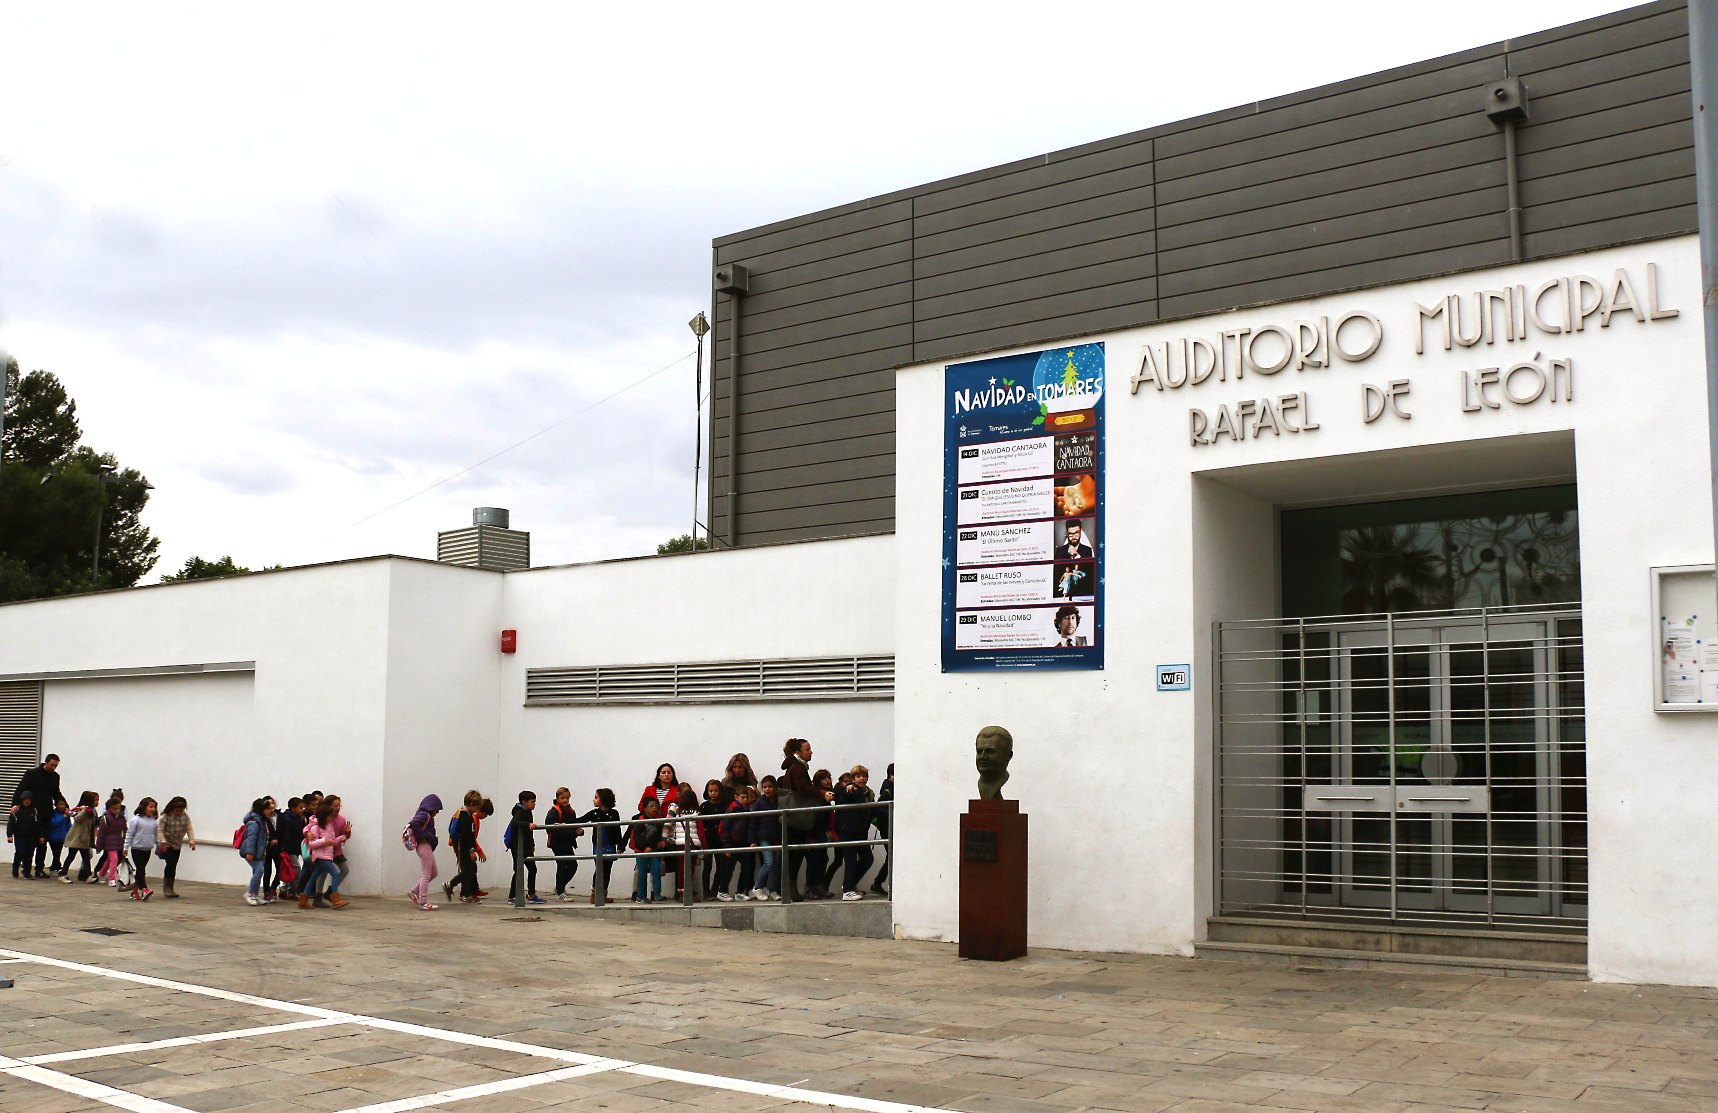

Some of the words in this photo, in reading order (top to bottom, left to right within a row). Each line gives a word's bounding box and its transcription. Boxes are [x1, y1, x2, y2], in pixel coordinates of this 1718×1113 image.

[1130, 309, 1383, 395] AUDITORIO
[1414, 262, 1680, 355] MUNICIPAL
[954, 384, 1026, 415] NAVIDAD
[1027, 393, 1037, 402] EN
[1037, 377, 1103, 401] TOMARES
[1188, 391, 1320, 446] RAFAEL
[1361, 378, 1411, 424] DE
[1460, 351, 1573, 412] LEÓN
[981, 446, 1010, 455] NAVIDAD
[1011, 442, 1047, 452] CANTAORA
[1060, 444, 1090, 458] NAVIDAD
[1056, 456, 1093, 469] CANTAORA
[1010, 485, 1034, 493] Navidad
[1001, 527, 1031, 536] SÁNCHEZ
[1003, 571, 1022, 579] RUSO
